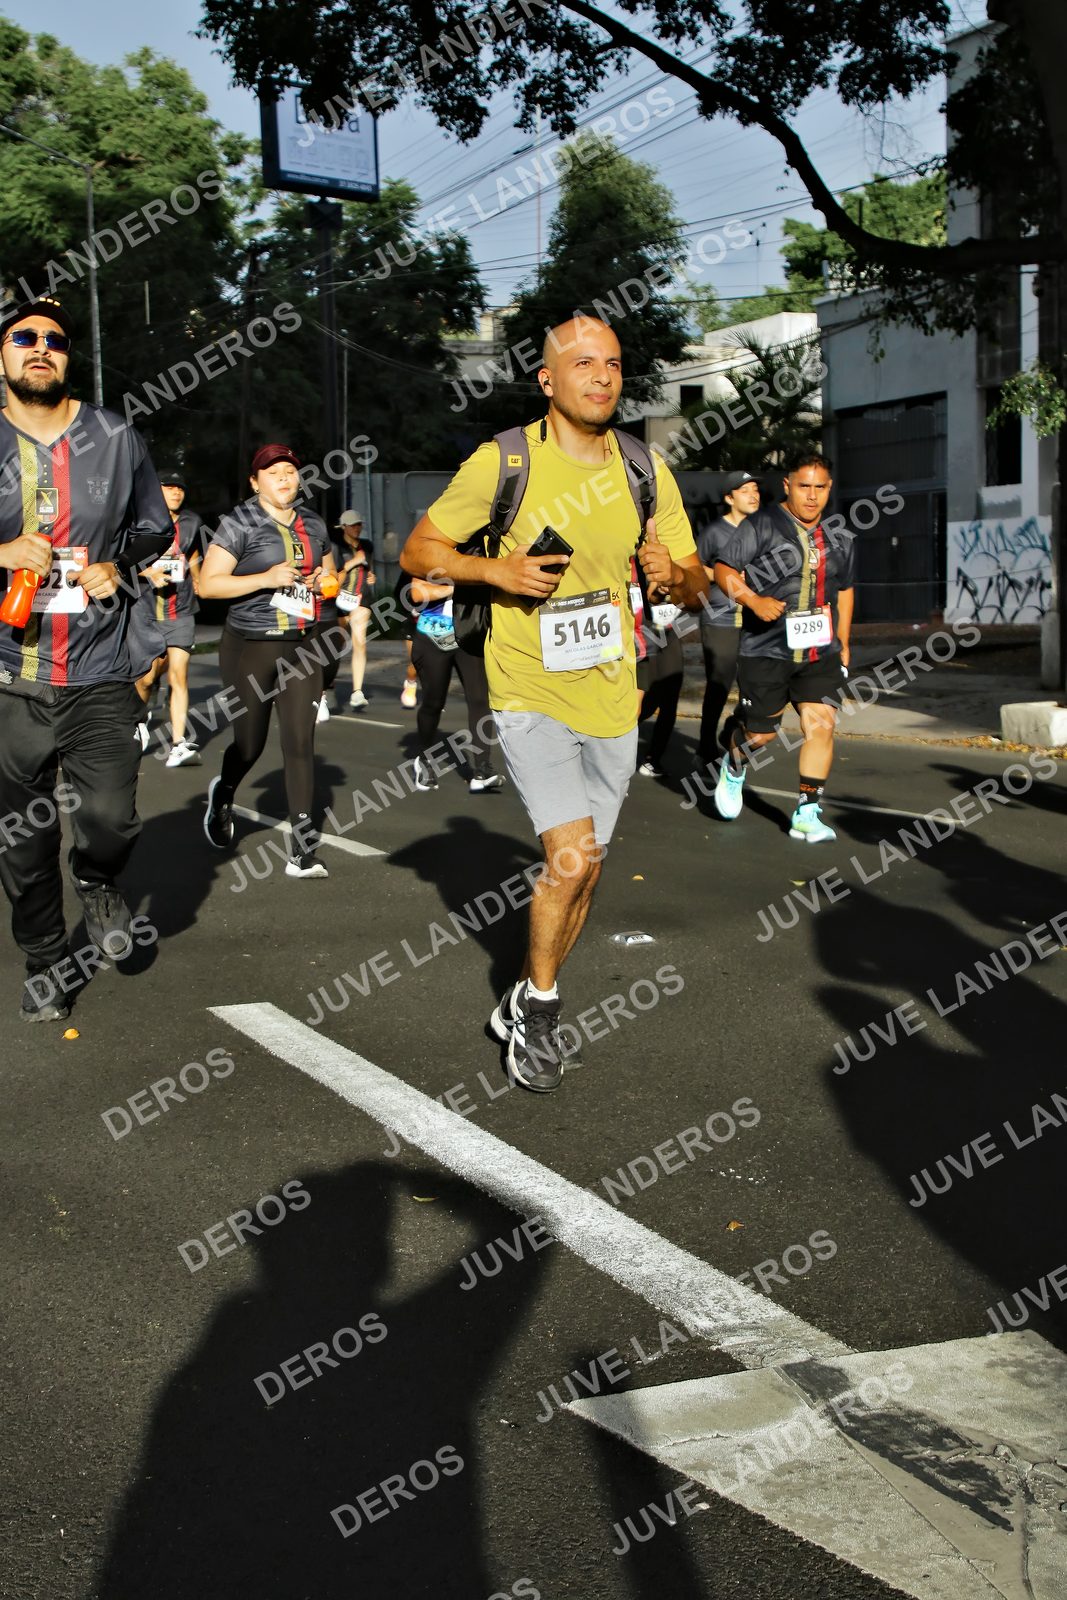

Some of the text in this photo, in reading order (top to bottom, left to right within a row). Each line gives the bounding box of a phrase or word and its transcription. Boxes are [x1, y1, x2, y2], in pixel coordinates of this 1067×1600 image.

[282, 586, 310, 603] 12048
[554, 613, 611, 647] 5146
[794, 620, 823, 634] 9289
